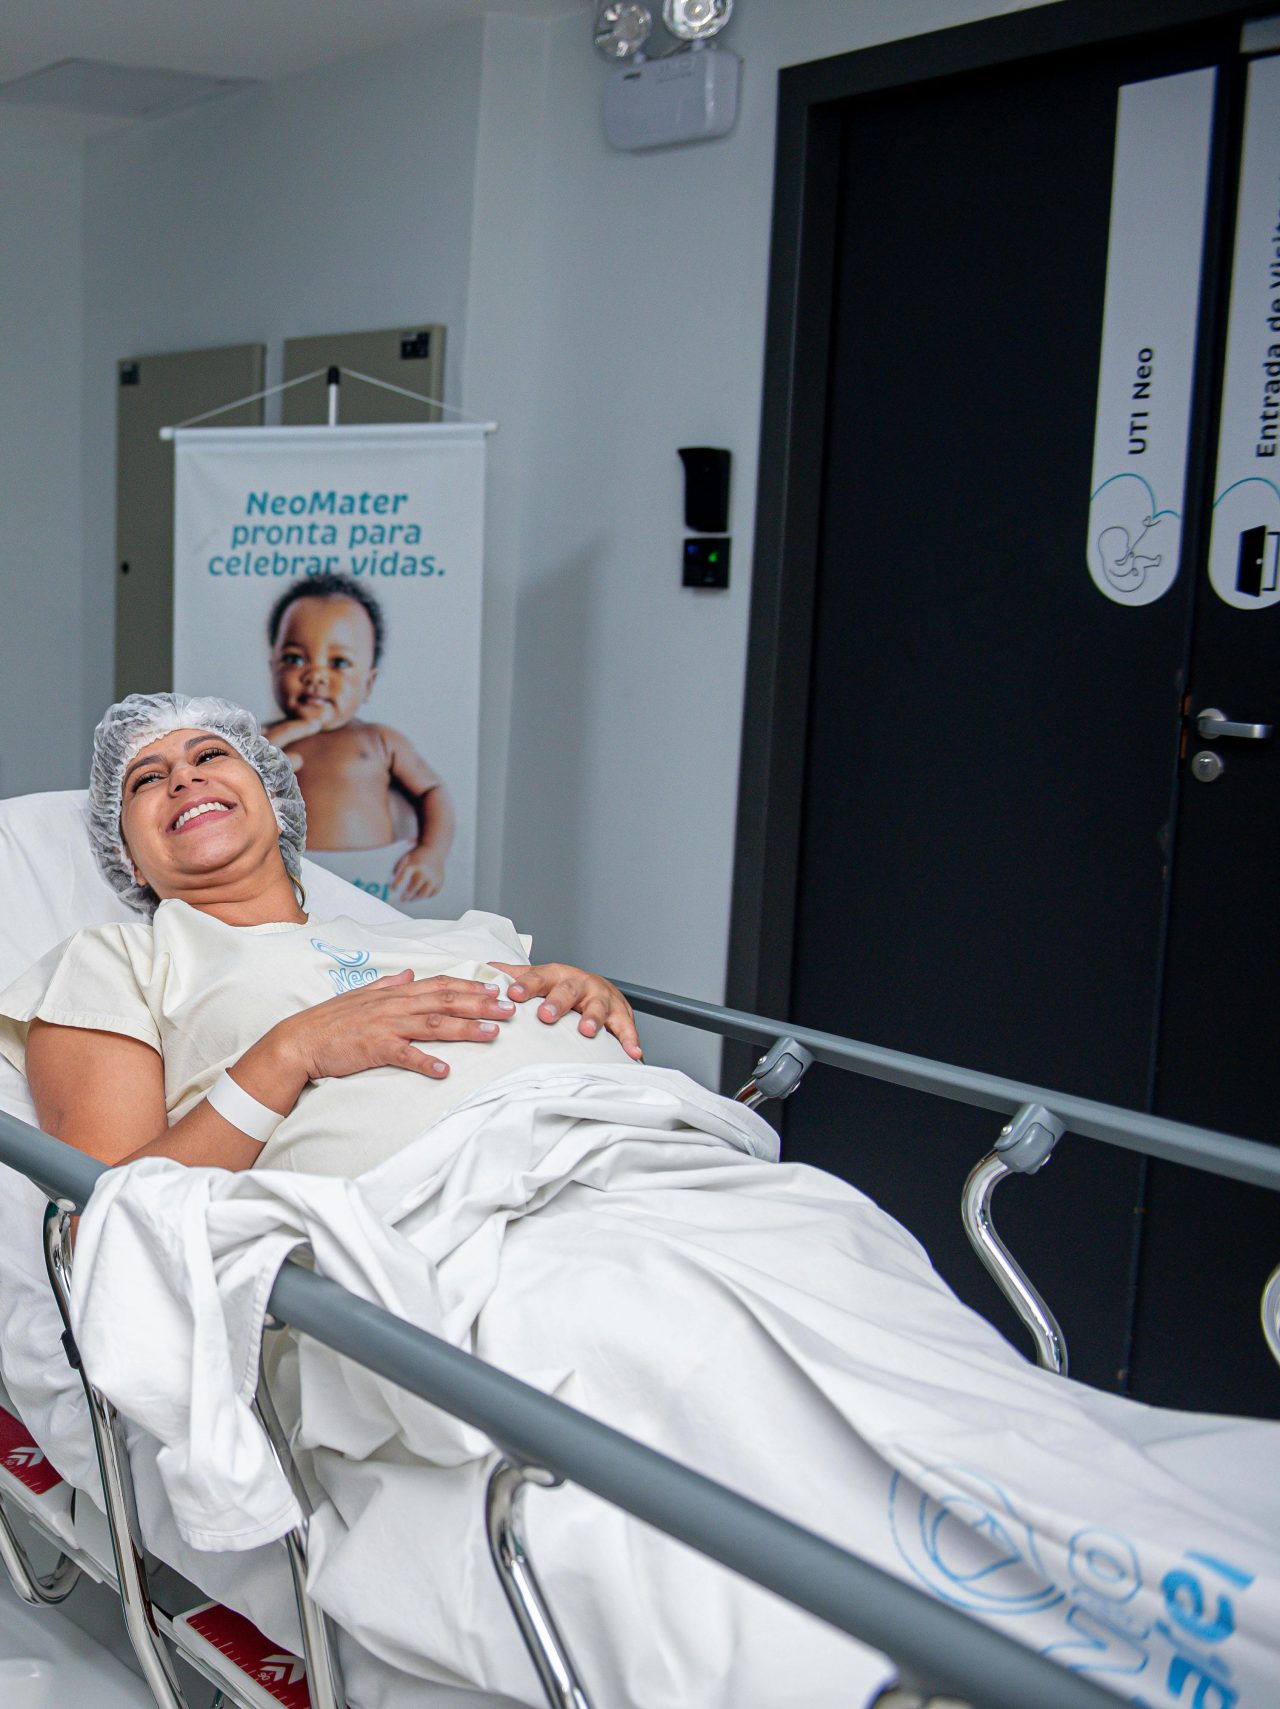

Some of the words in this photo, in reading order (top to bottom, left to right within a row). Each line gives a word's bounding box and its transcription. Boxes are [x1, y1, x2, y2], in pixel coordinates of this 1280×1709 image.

[1132, 347, 1154, 400] Neo
[1256, 344, 1280, 458] Entrada
[1128, 412, 1150, 455] UTI
[246, 490, 408, 516] NeoMater
[231, 522, 337, 549] pronta
[348, 523, 422, 549] para
[208, 551, 339, 577] celebrar
[351, 550, 445, 577] vidas.
